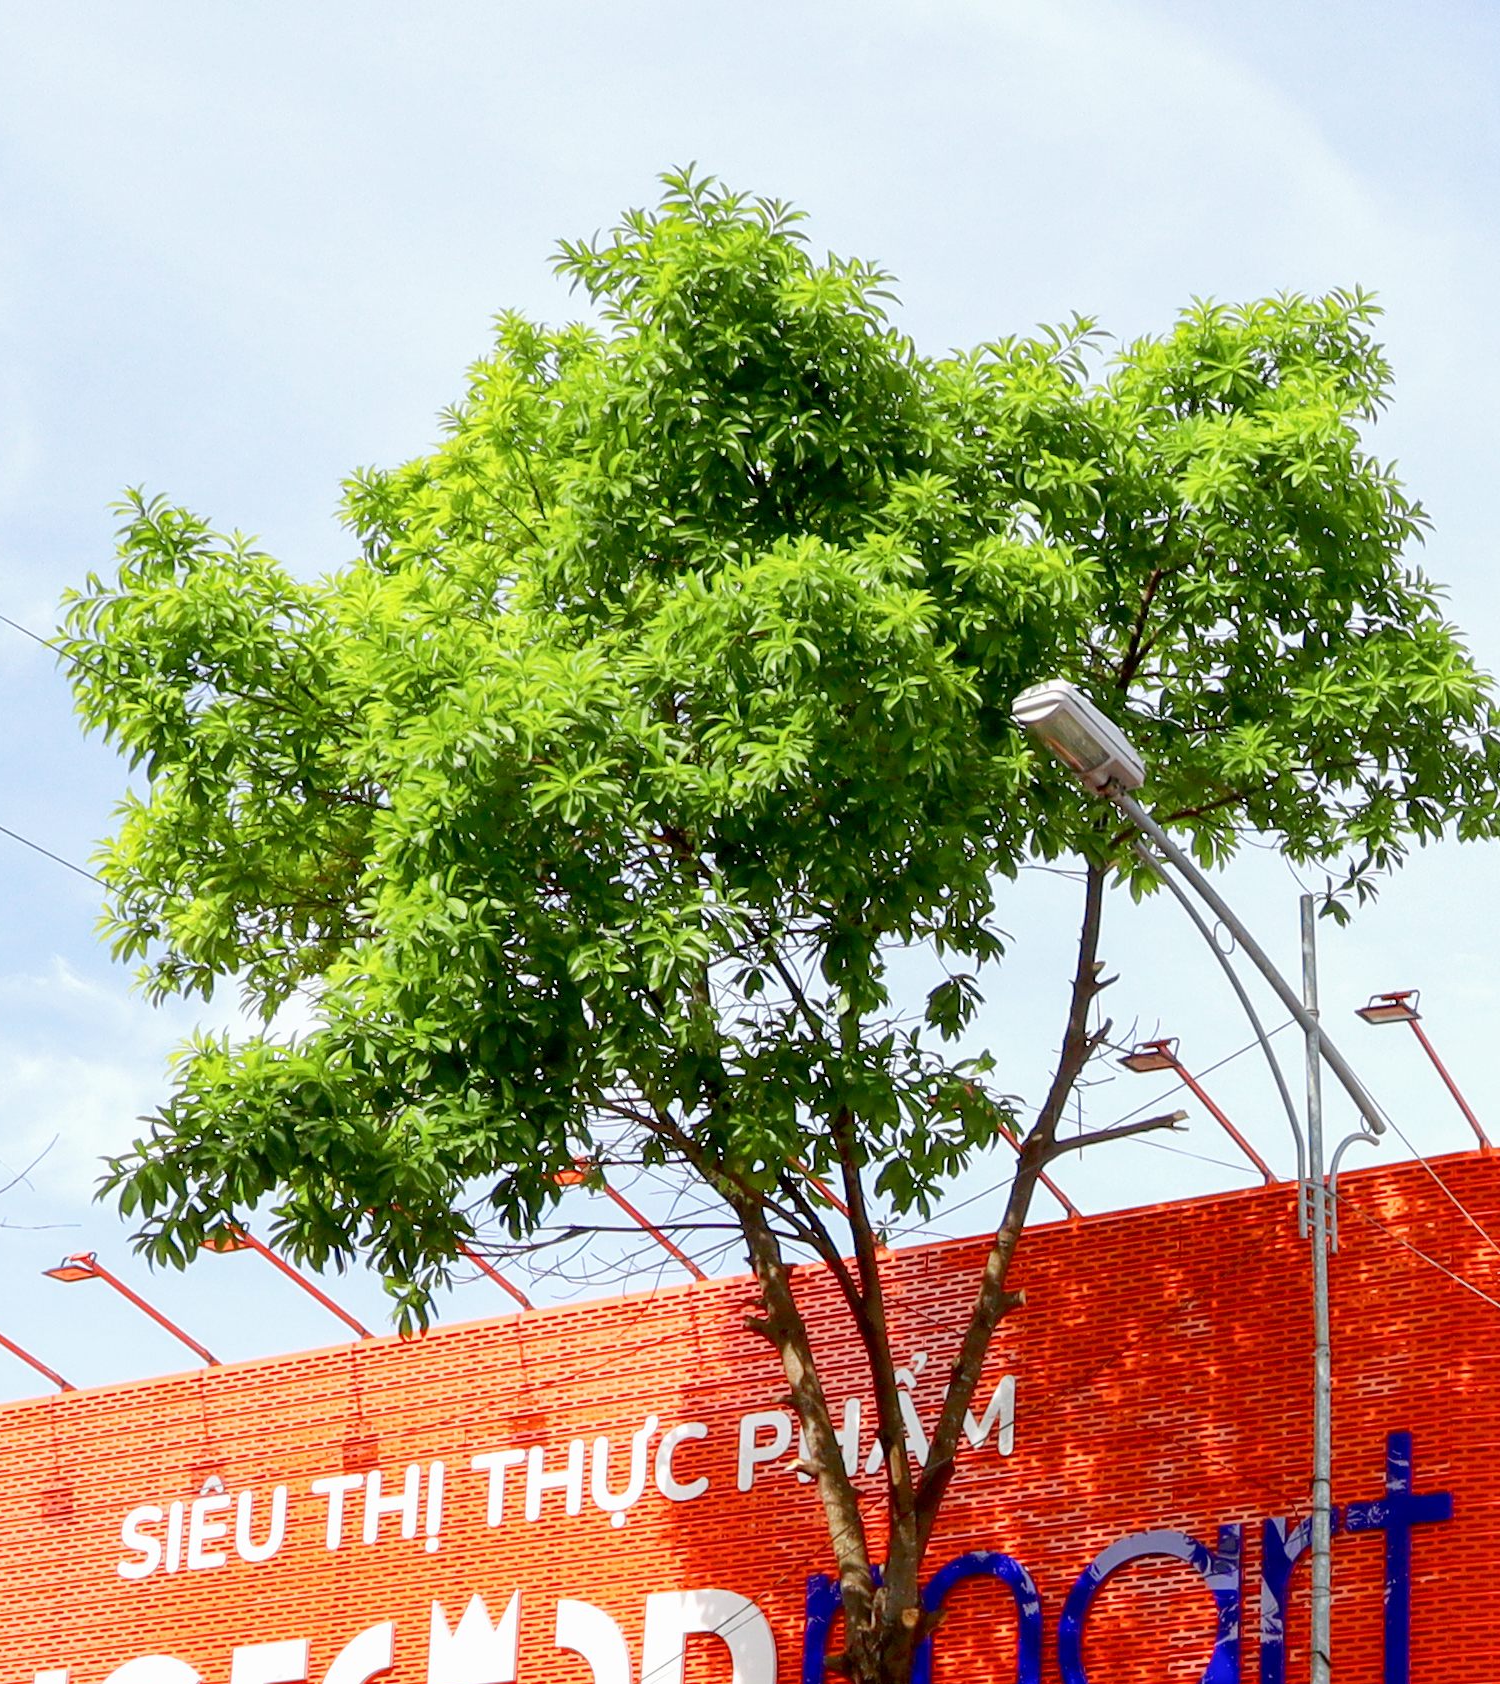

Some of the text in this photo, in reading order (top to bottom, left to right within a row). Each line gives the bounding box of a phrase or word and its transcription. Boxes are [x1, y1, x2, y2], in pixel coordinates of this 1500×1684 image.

[117, 1474, 289, 1580] SIÊU
[311, 1459, 446, 1553] THỊ
[470, 1414, 709, 1528] THỰC
